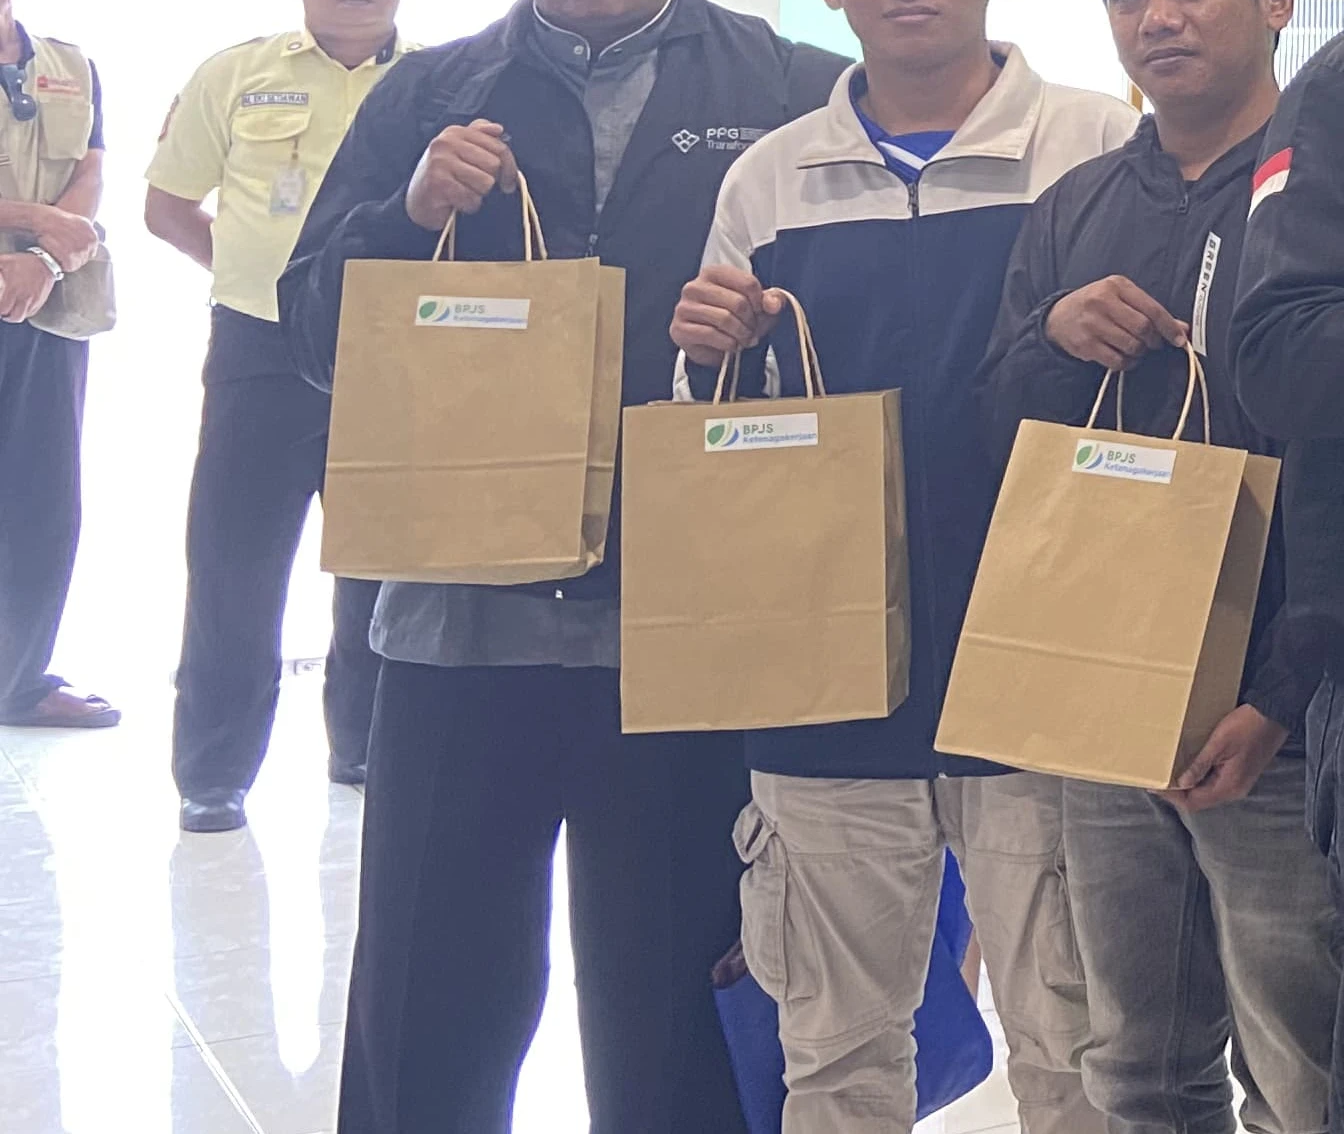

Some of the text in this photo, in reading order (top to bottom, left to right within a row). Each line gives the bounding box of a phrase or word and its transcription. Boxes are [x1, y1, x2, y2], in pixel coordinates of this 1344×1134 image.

[706, 127, 739, 140] PPG
[1200, 239, 1217, 292] GREEN
[454, 304, 486, 314] BPJS
[743, 423, 774, 435] BPJS
[1107, 450, 1137, 464] BPJS
